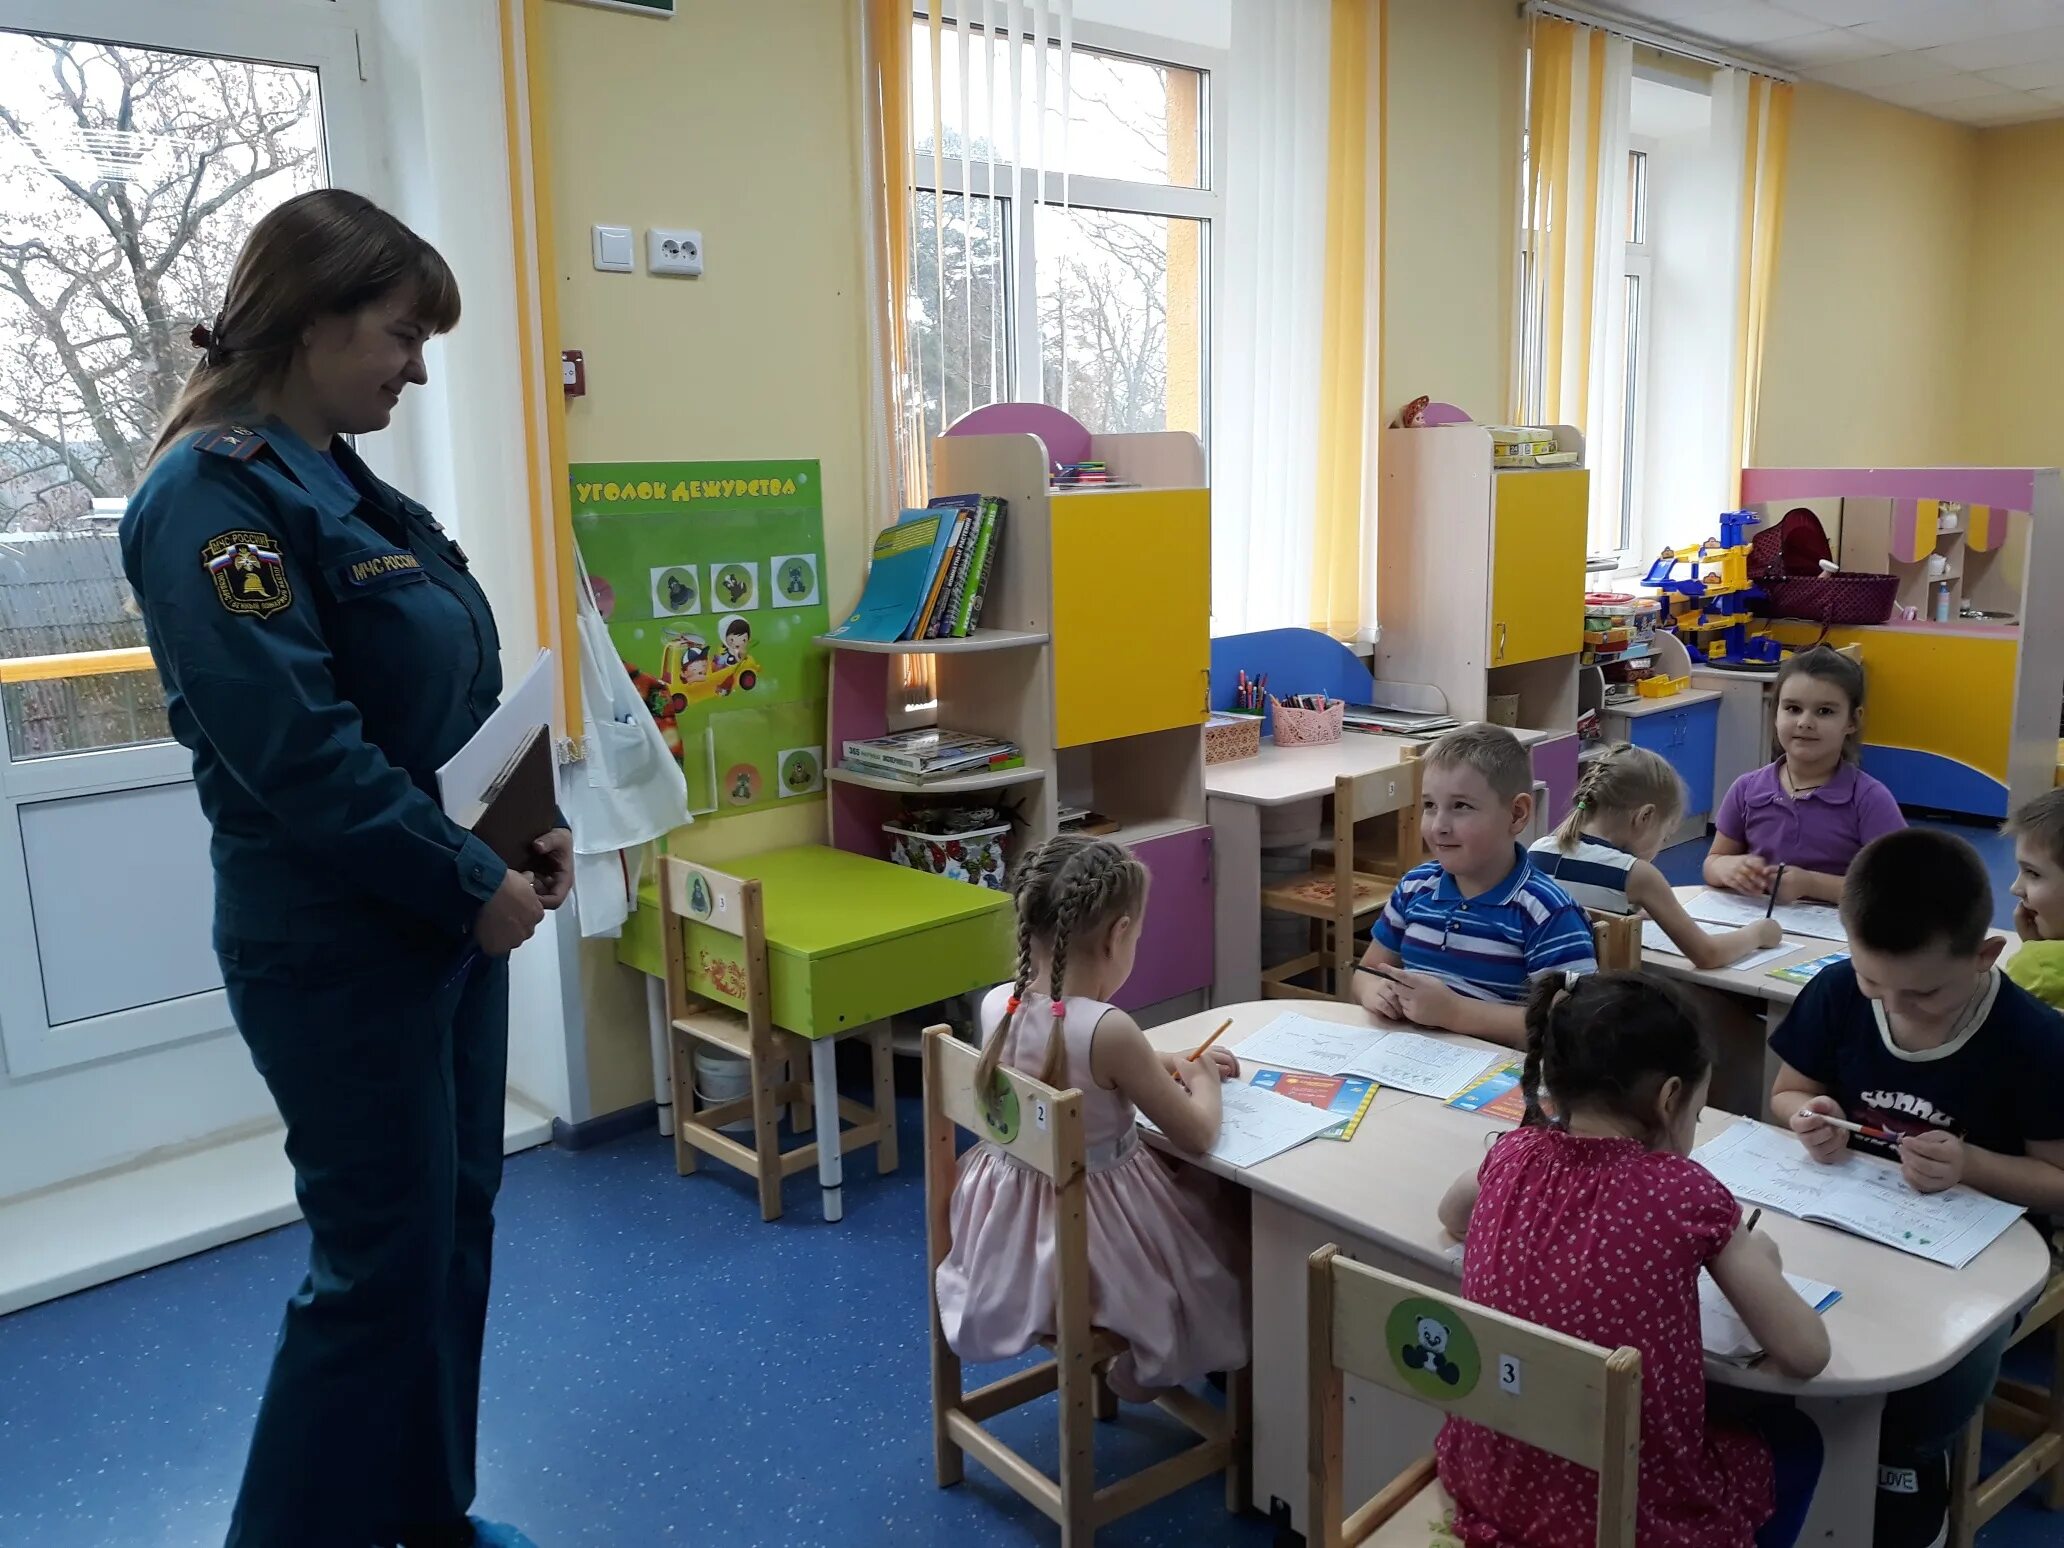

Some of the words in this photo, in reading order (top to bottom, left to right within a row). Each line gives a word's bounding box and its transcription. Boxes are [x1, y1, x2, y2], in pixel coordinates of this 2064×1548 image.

[576, 481, 667, 503] УГОЛОК
[671, 478, 797, 502] ДЕЖУРСТВА
[212, 536, 231, 552] МЧС
[232, 534, 268, 547] РОССИИ
[352, 558, 384, 580] МЧС
[382, 554, 421, 571] РОССИИ
[1038, 1106, 1044, 1121] 2
[1503, 1363, 1515, 1384] 3
[1879, 1471, 1913, 1490] LOVE
